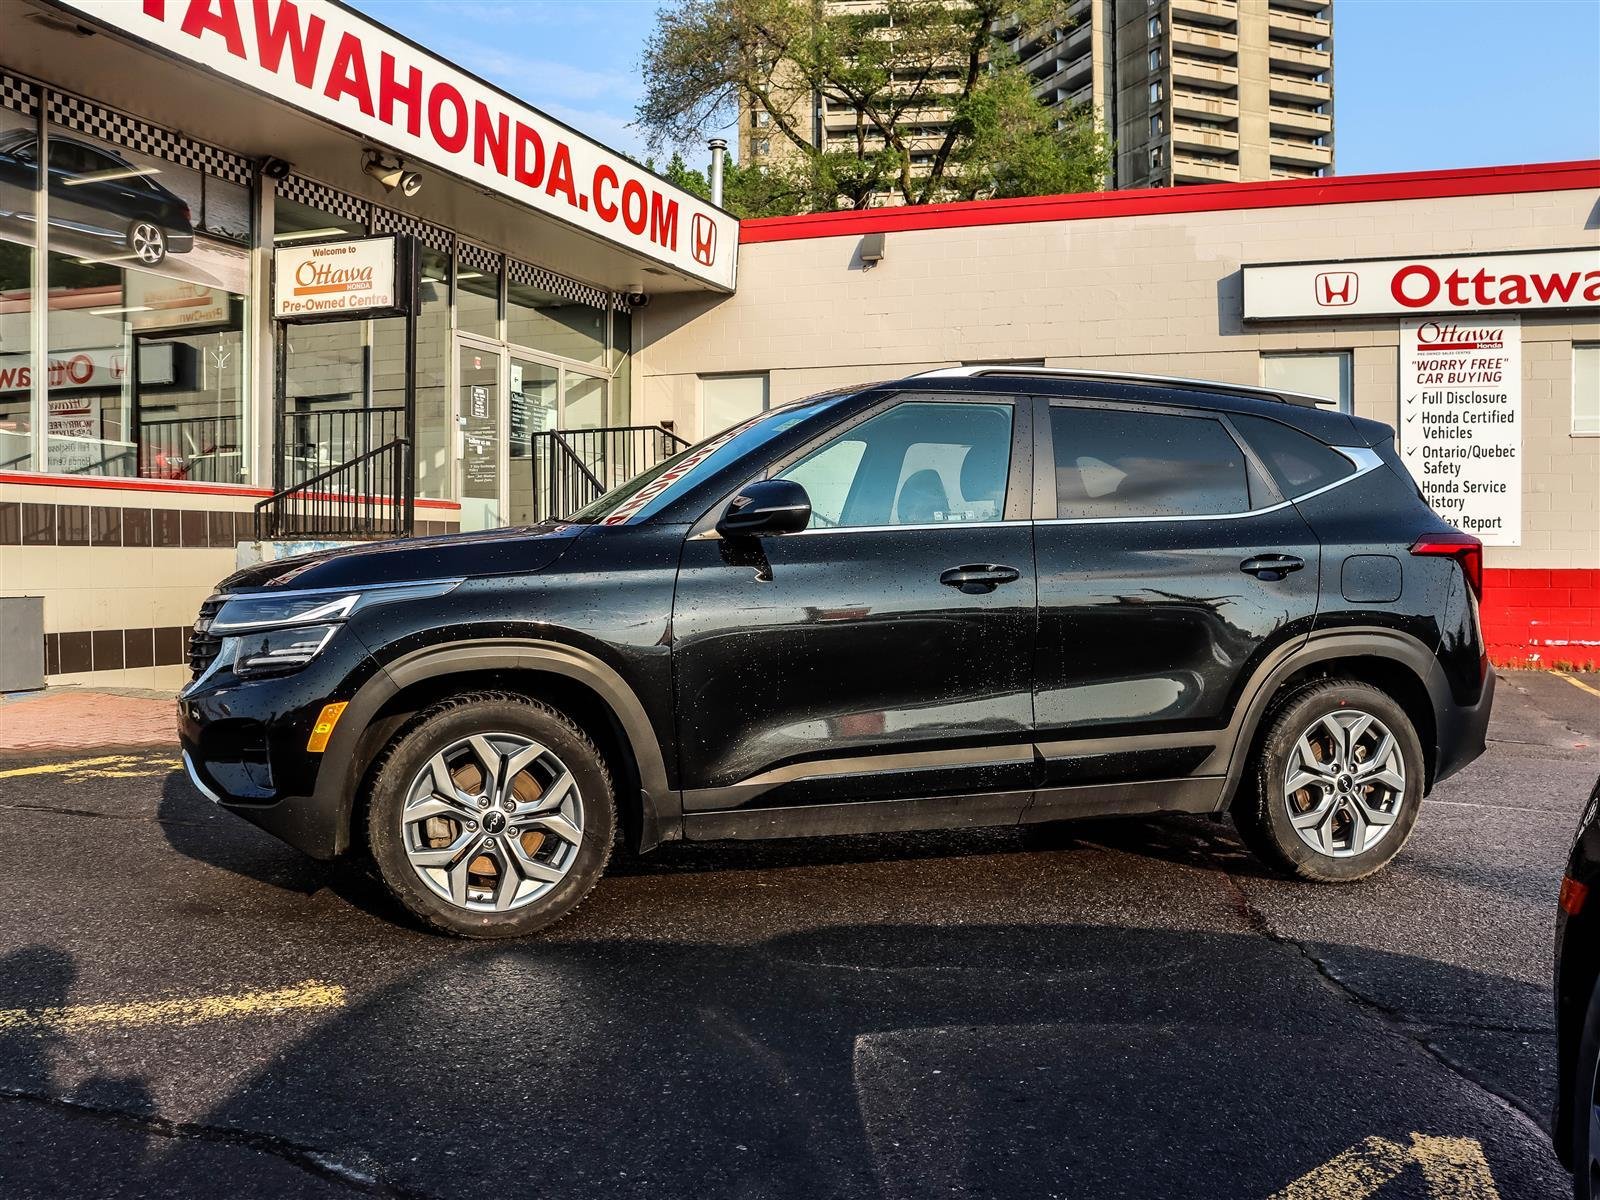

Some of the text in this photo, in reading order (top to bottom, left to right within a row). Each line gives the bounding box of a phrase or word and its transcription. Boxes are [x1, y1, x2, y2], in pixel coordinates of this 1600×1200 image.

[312, 246, 357, 257] Welcome to
[295, 260, 373, 287] Ottawa
[346, 282, 371, 290] HONDA
[282, 293, 388, 312] Pre-Owned Centre
[1416, 321, 1504, 343] Ottawa
[1412, 357, 1509, 371] "WORRY FREE"
[1417, 371, 1502, 384] CAR BUYING
[1422, 391, 1507, 405] Full Disclosure
[1421, 410, 1514, 425] Honda Certified
[1422, 426, 1473, 440] Vehicles
[1422, 444, 1516, 459] Ontario/Quebec
[1423, 461, 1461, 477] Safety
[1422, 480, 1507, 493] Honda Service
[1463, 516, 1502, 532] Report
